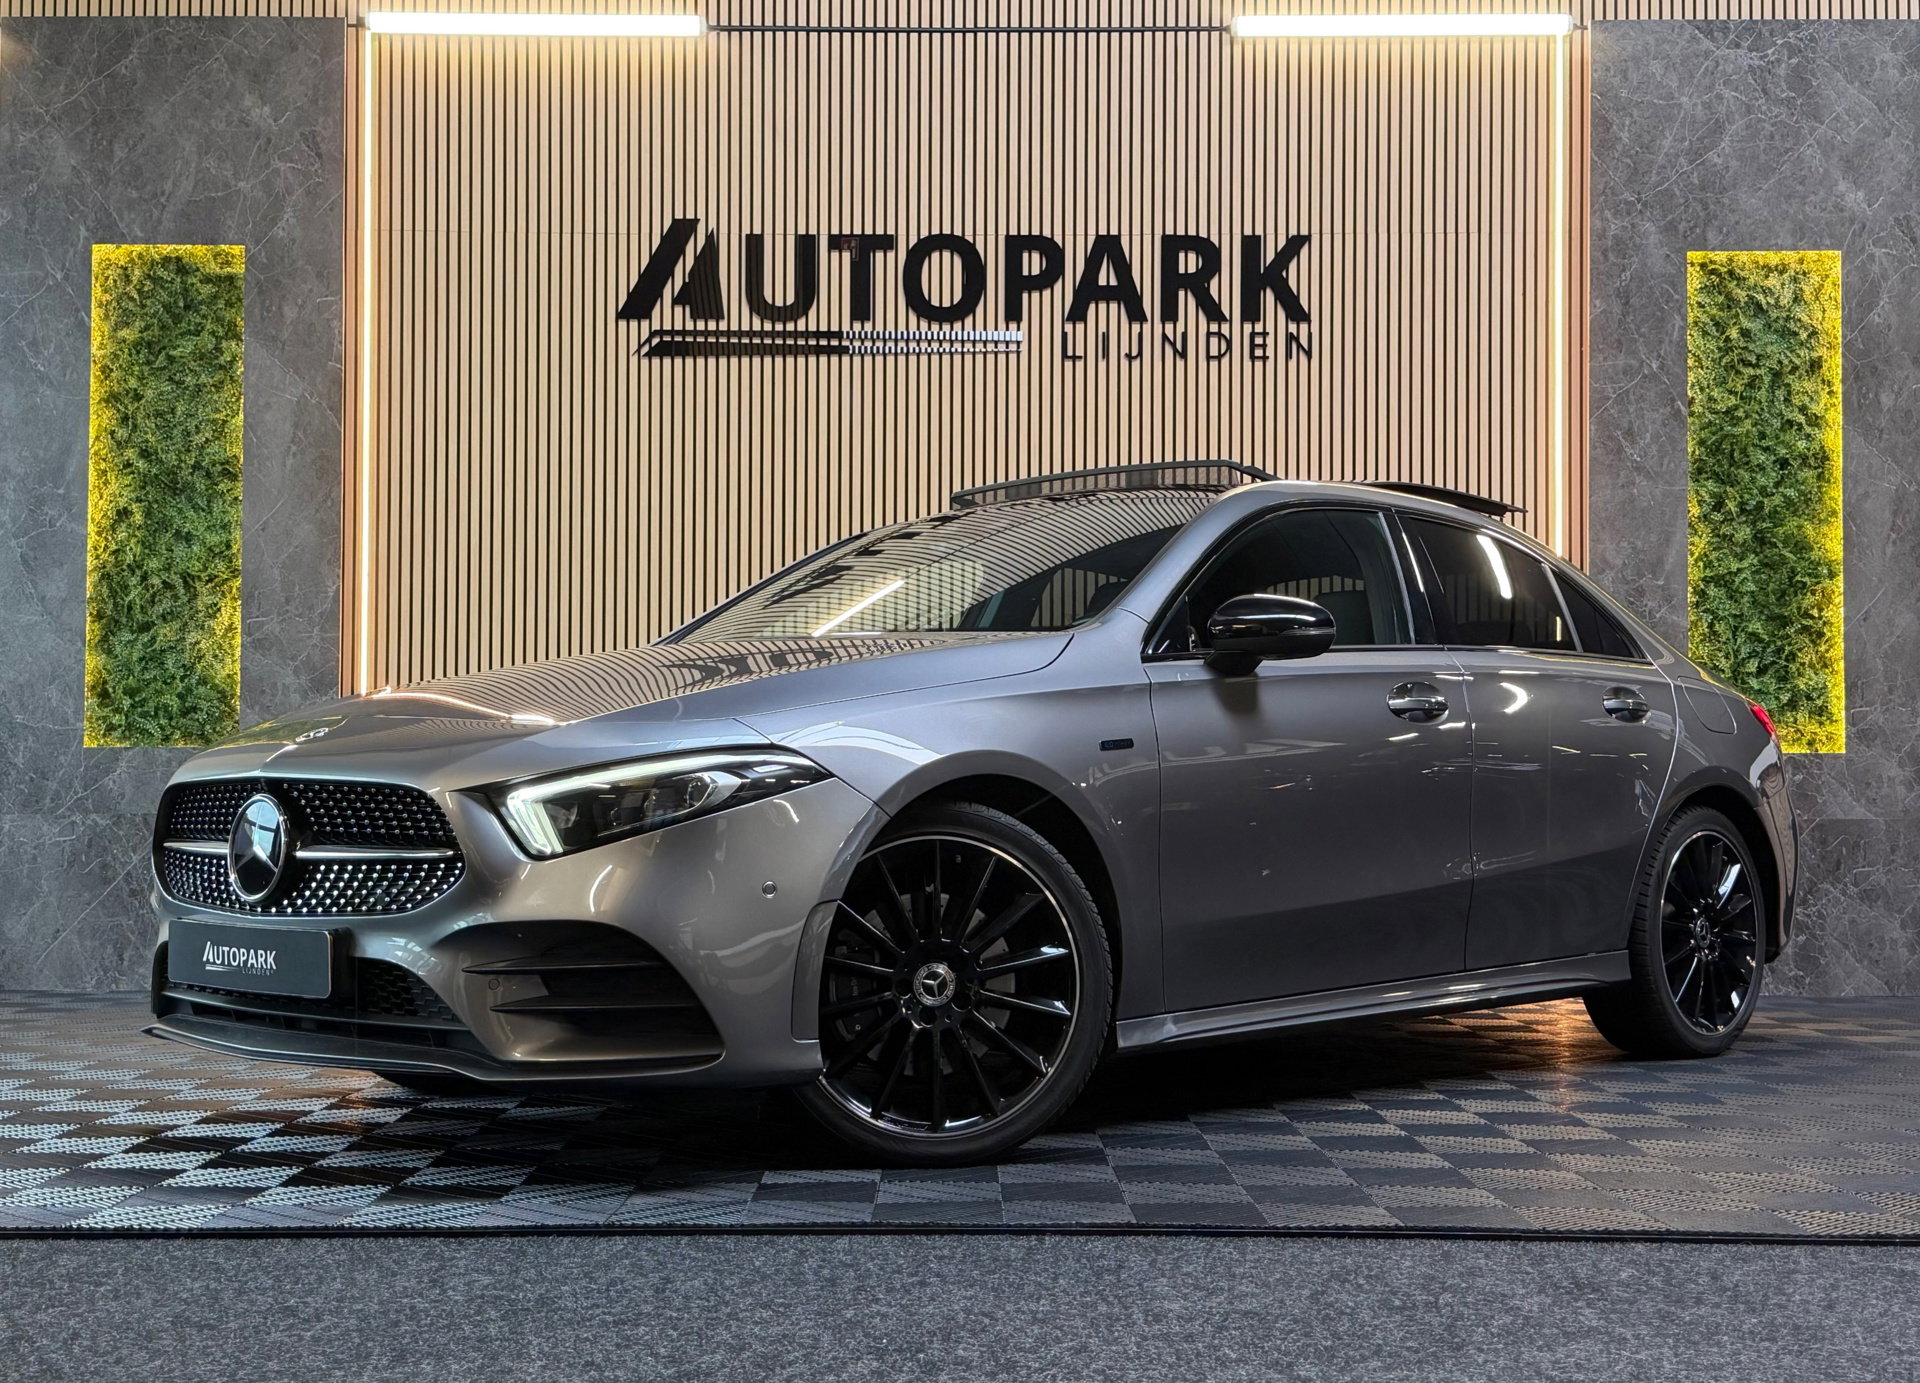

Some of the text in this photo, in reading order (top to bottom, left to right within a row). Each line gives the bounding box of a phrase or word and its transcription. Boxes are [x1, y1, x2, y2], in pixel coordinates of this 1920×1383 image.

[615, 218, 1311, 322] AUTOPARK
[1062, 331, 1312, 360] LIJNDEN
[203, 941, 277, 970] AUTOPARK
